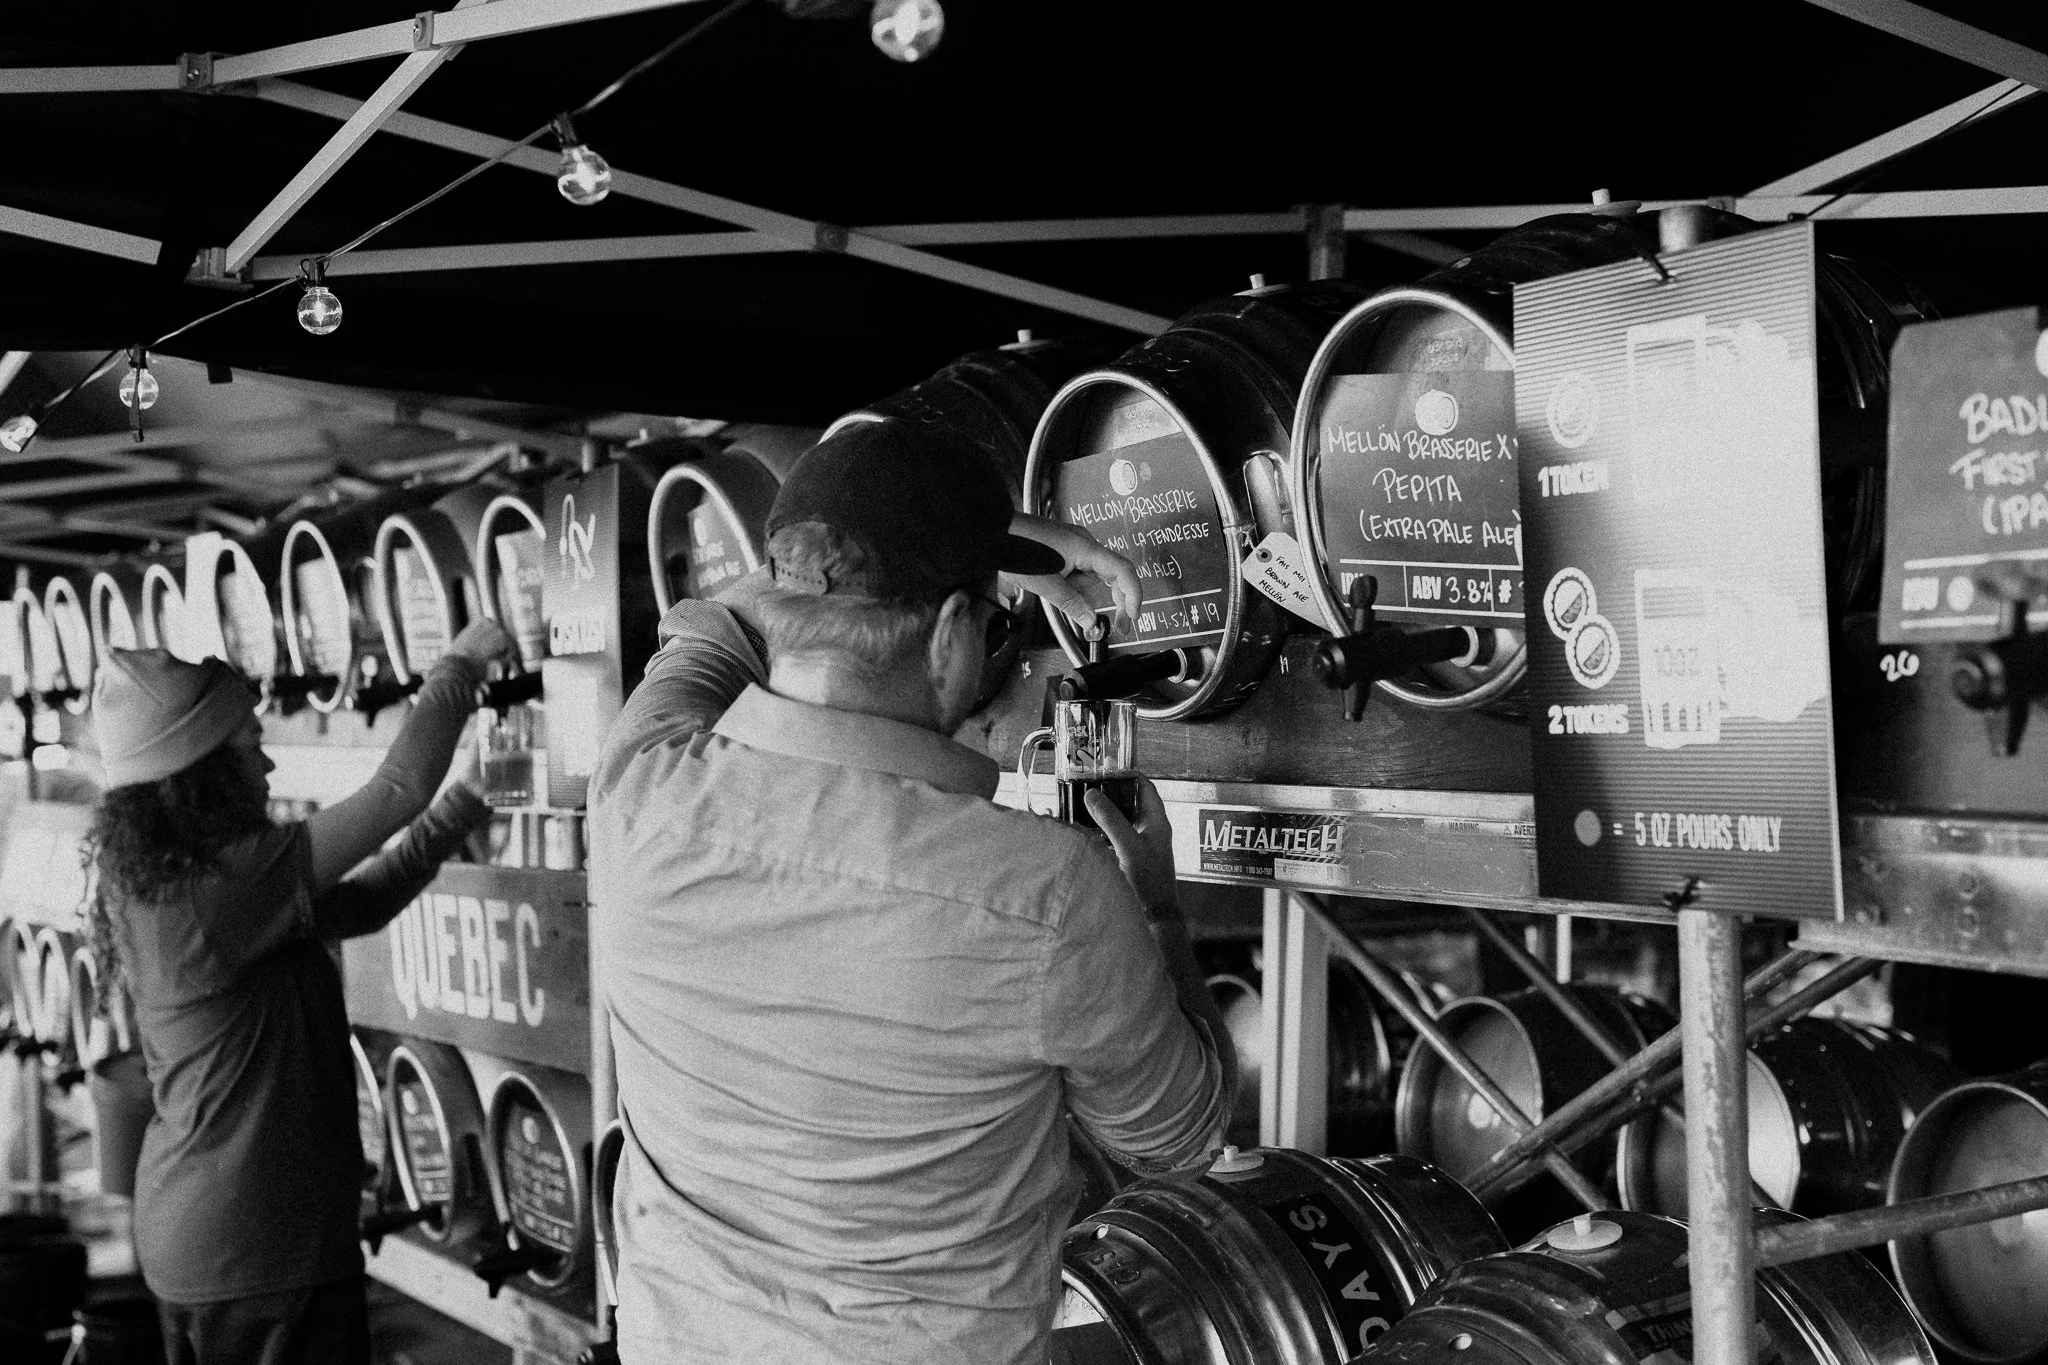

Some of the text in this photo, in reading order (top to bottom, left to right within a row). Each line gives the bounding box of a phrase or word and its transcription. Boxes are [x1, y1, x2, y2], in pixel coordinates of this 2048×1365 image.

[1402, 430, 1493, 462] BRASSERIE
[1372, 467, 1463, 504] PEPITA
[1124, 489, 1198, 523] BRASSERIE
[1145, 522, 1210, 546] TENDRESSE
[1426, 518, 1473, 544] PALE
[1412, 575, 1442, 600] ABV
[1445, 576, 1493, 604] 3.8%
[1137, 616, 1157, 633] ABV
[1158, 611, 1190, 630] 4.5%
[1202, 602, 1220, 623] 19
[1547, 703, 1629, 734] 2 TOKENS
[1634, 811, 1647, 847] 5
[1651, 812, 1672, 848] OZ
[1676, 813, 1733, 850] POURS
[1737, 814, 1782, 852] ONLY
[389, 891, 545, 1027] QUEBEC
